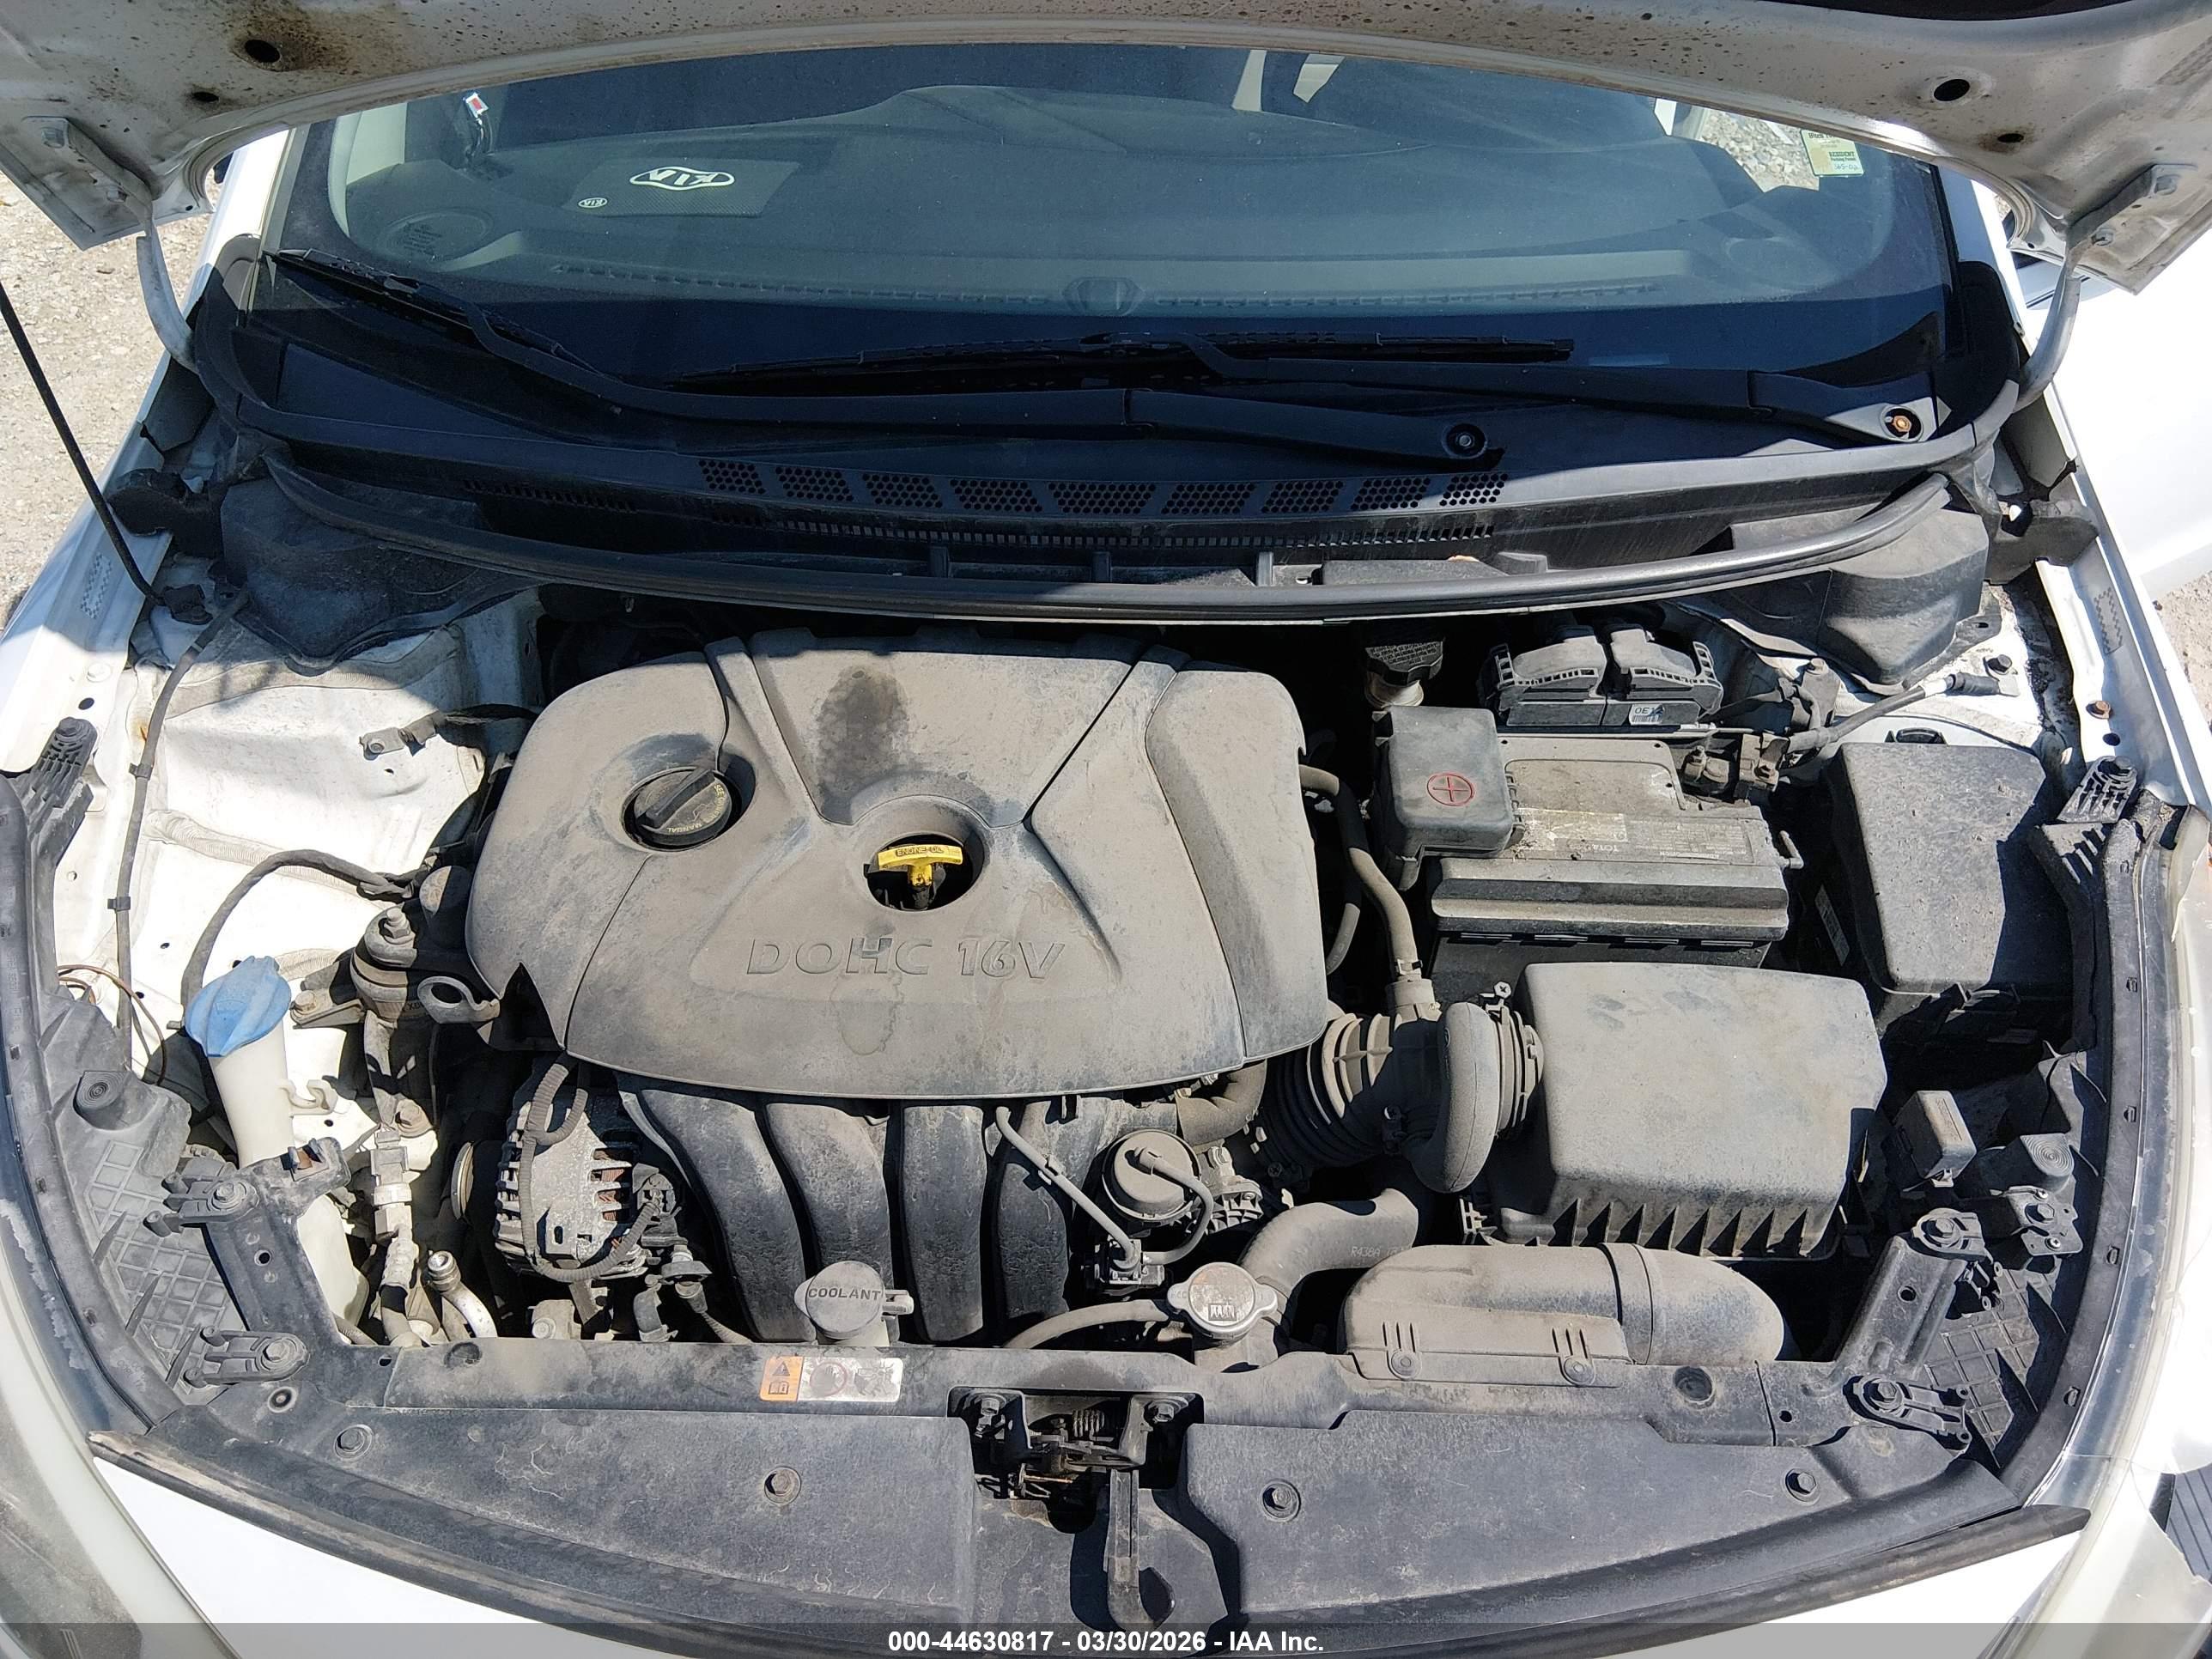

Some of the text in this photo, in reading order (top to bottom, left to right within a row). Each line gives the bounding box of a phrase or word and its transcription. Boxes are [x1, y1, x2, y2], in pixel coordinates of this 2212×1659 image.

[714, 783, 725, 797] SEE
[666, 822, 702, 833] MANUAL
[896, 847, 927, 856] ENGINE
[746, 937, 1066, 980] DOHC 16V
[808, 1287, 881, 1301] COOLANT
